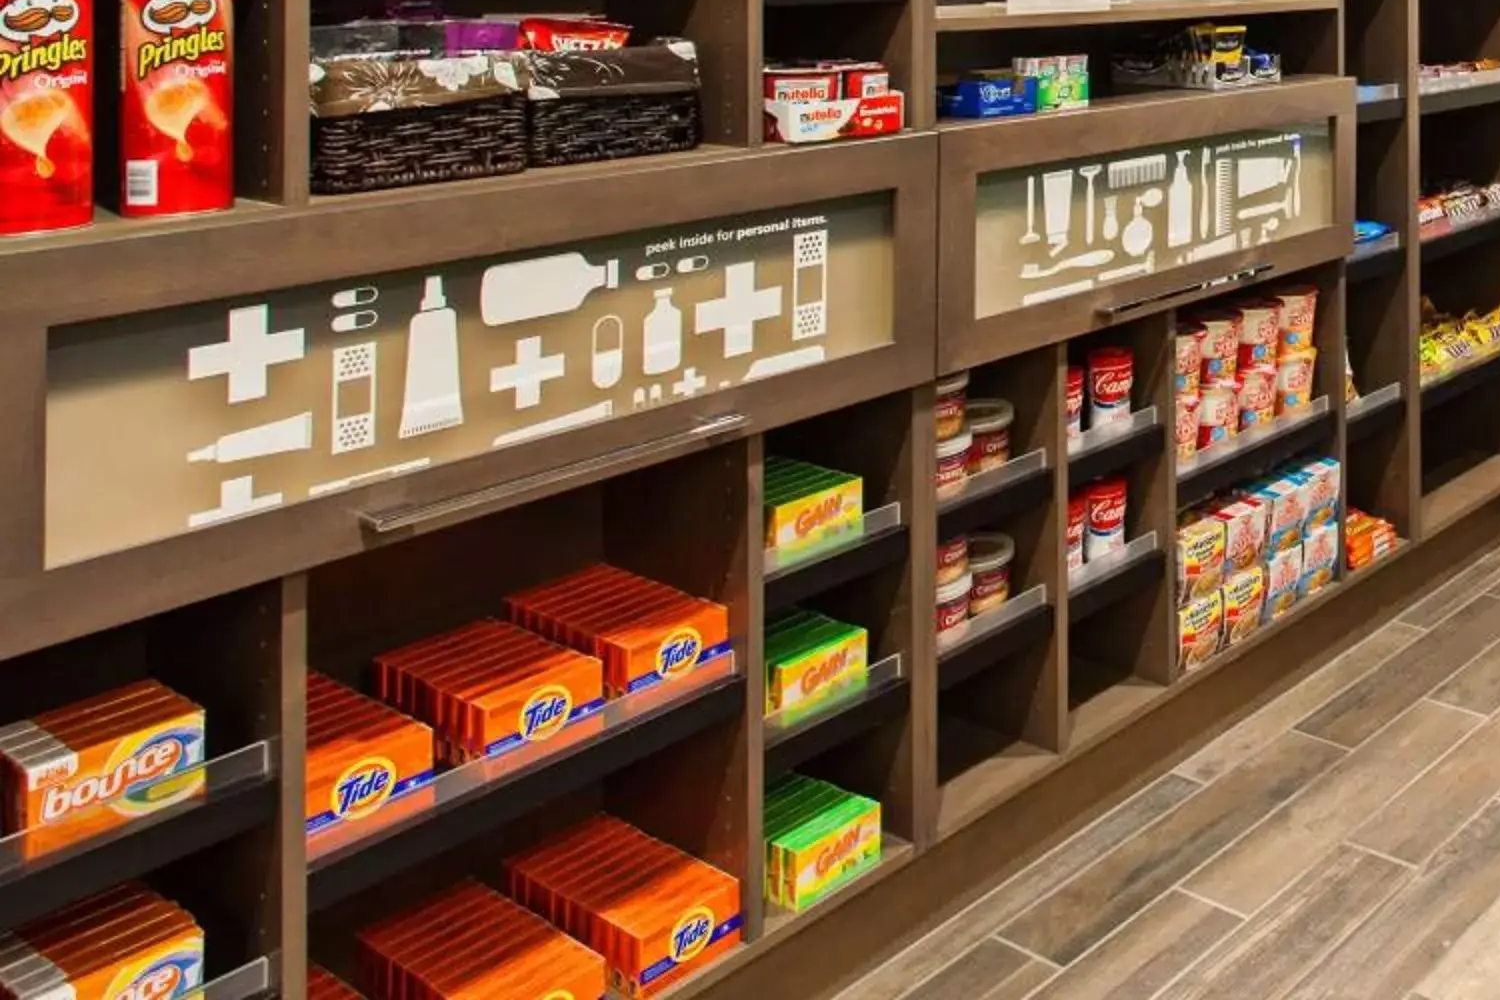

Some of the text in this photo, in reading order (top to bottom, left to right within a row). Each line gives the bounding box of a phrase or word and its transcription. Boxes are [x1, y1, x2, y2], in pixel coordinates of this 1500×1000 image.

[138, 26, 225, 78] Pringles
[777, 87, 825, 102] nutella
[645, 238, 676, 257] peek
[679, 232, 714, 250] inside
[717, 227, 734, 242] for
[736, 217, 790, 241] personal
[658, 637, 698, 675] Tide
[523, 696, 569, 736] Tide
[42, 738, 183, 824] bounce
[337, 768, 390, 815] Tide
[673, 919, 711, 954] Tide
